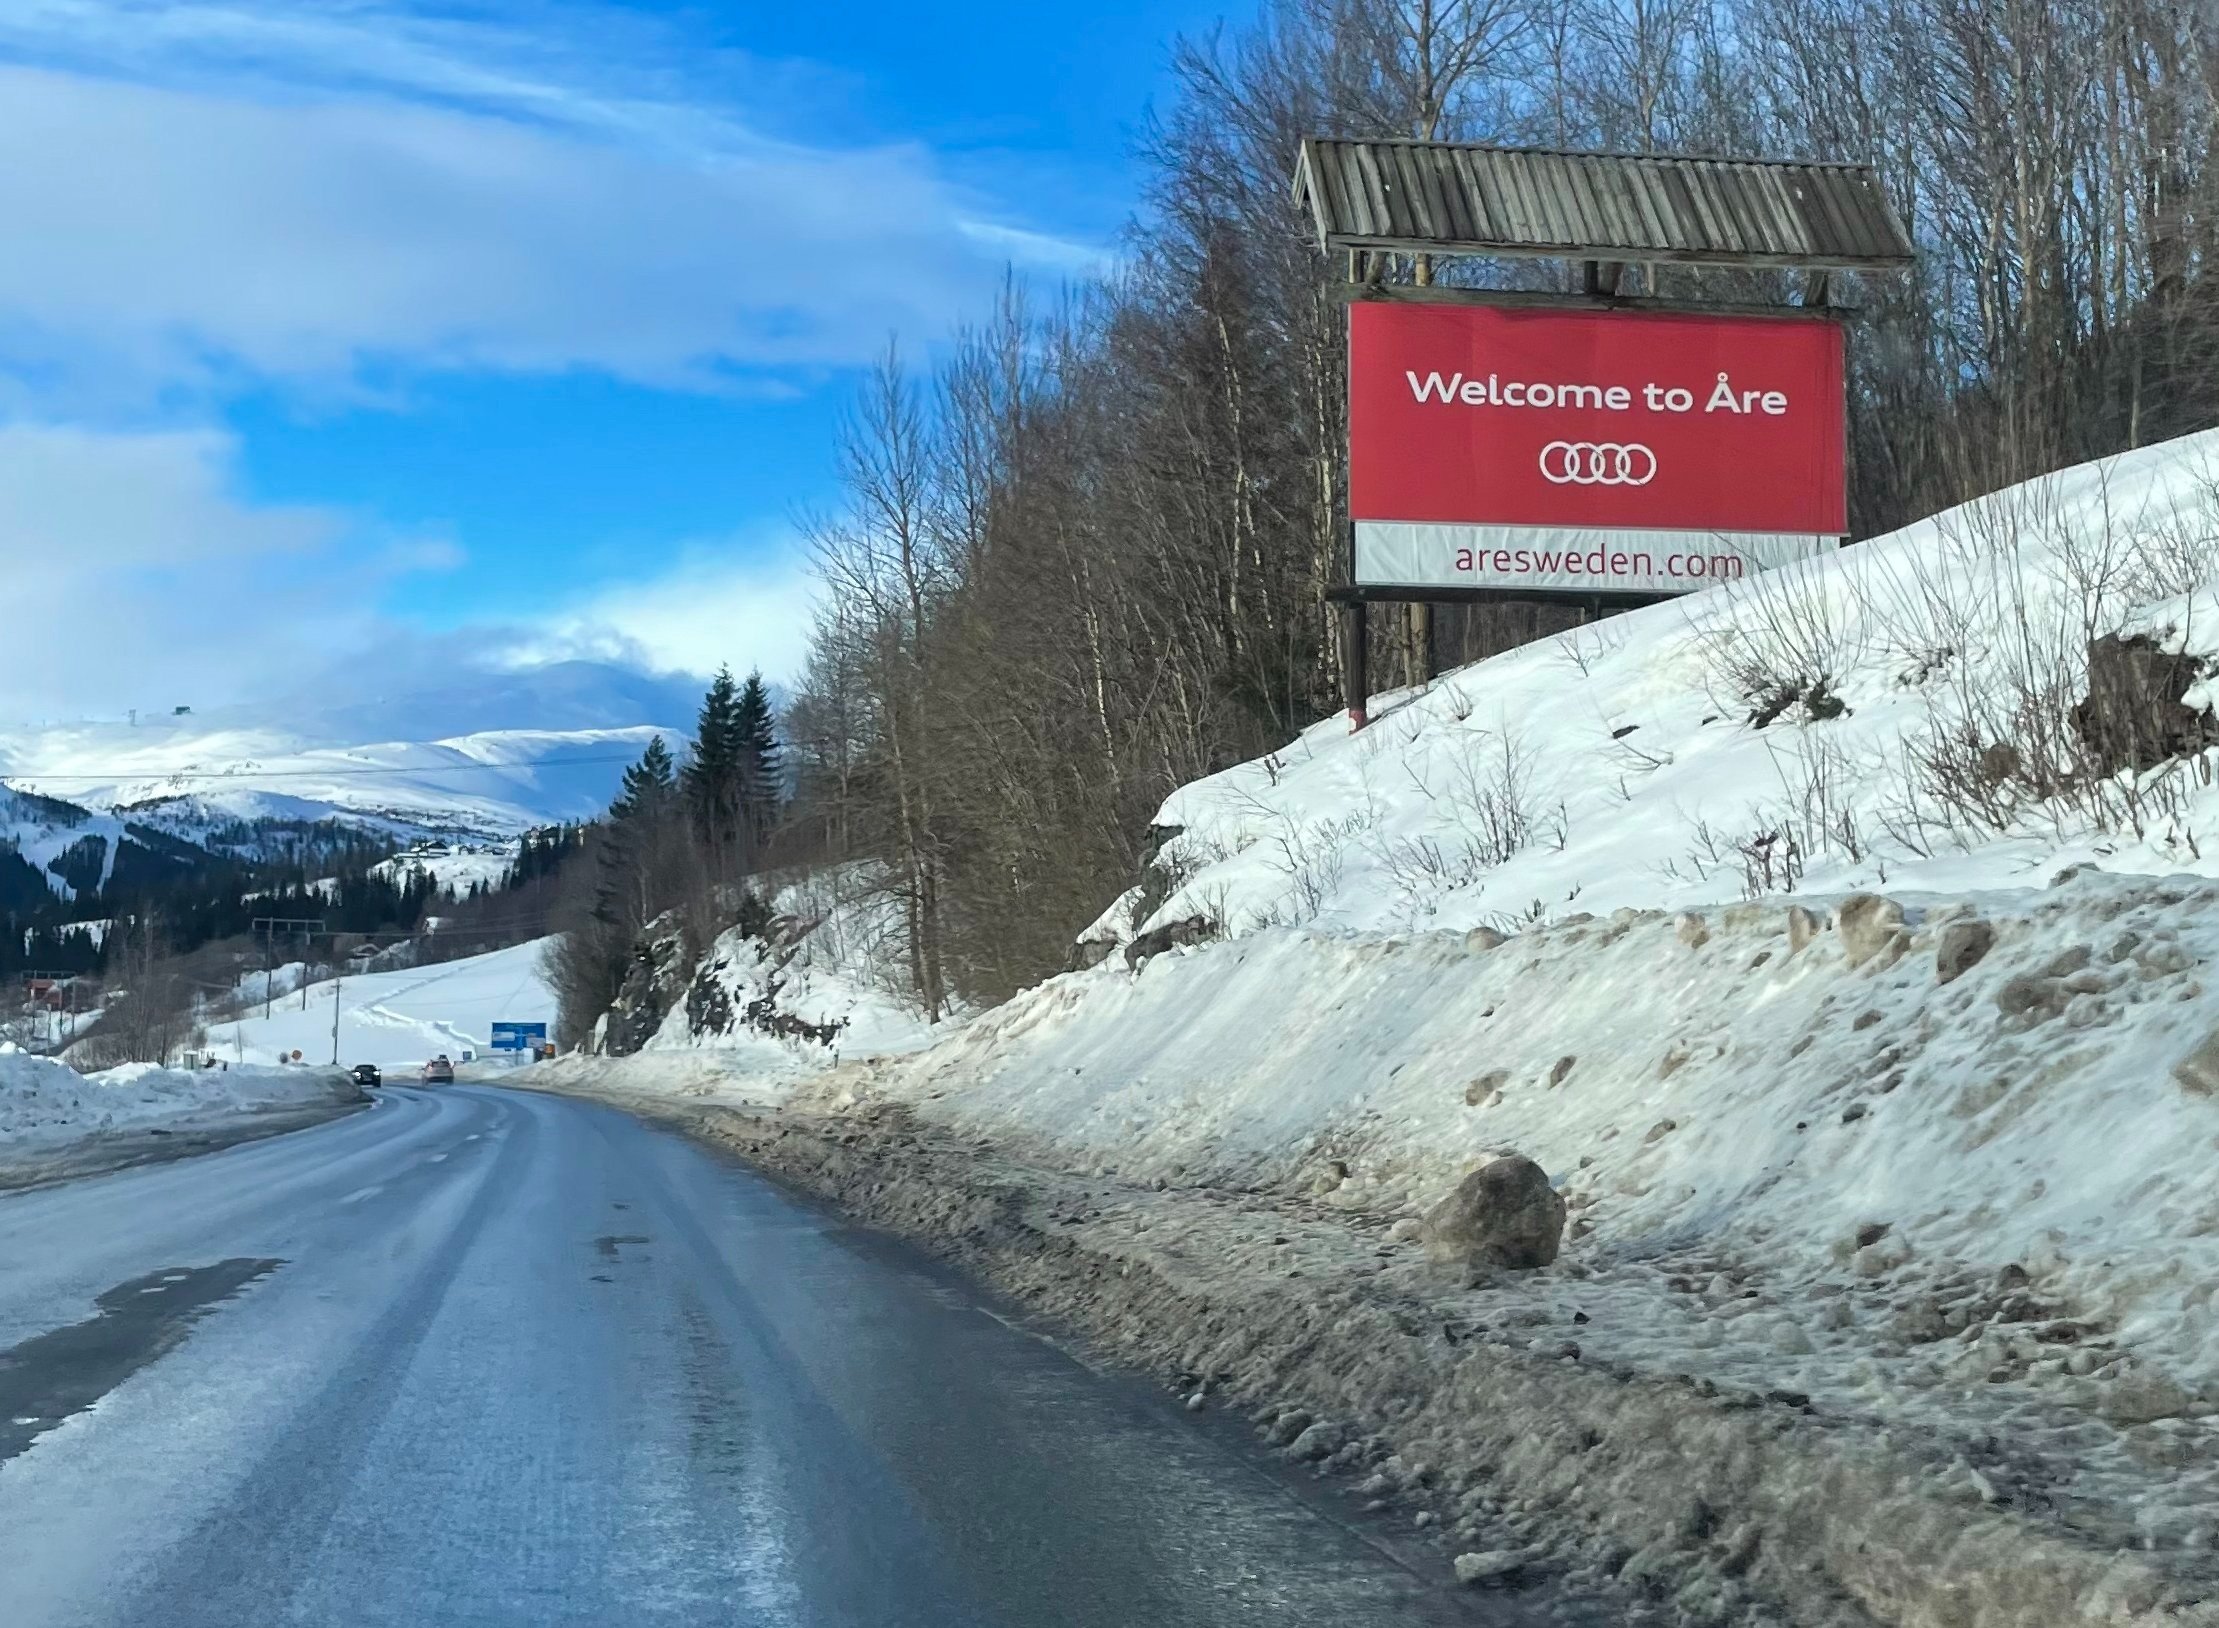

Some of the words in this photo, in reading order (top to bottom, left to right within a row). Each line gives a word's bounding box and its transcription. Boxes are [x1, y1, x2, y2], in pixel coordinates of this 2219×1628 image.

[1405, 370, 1632, 411] Welcome
[1643, 381, 1695, 413] to
[1705, 371, 1788, 415] Åre
[1455, 542, 1743, 579] aresweden.com
